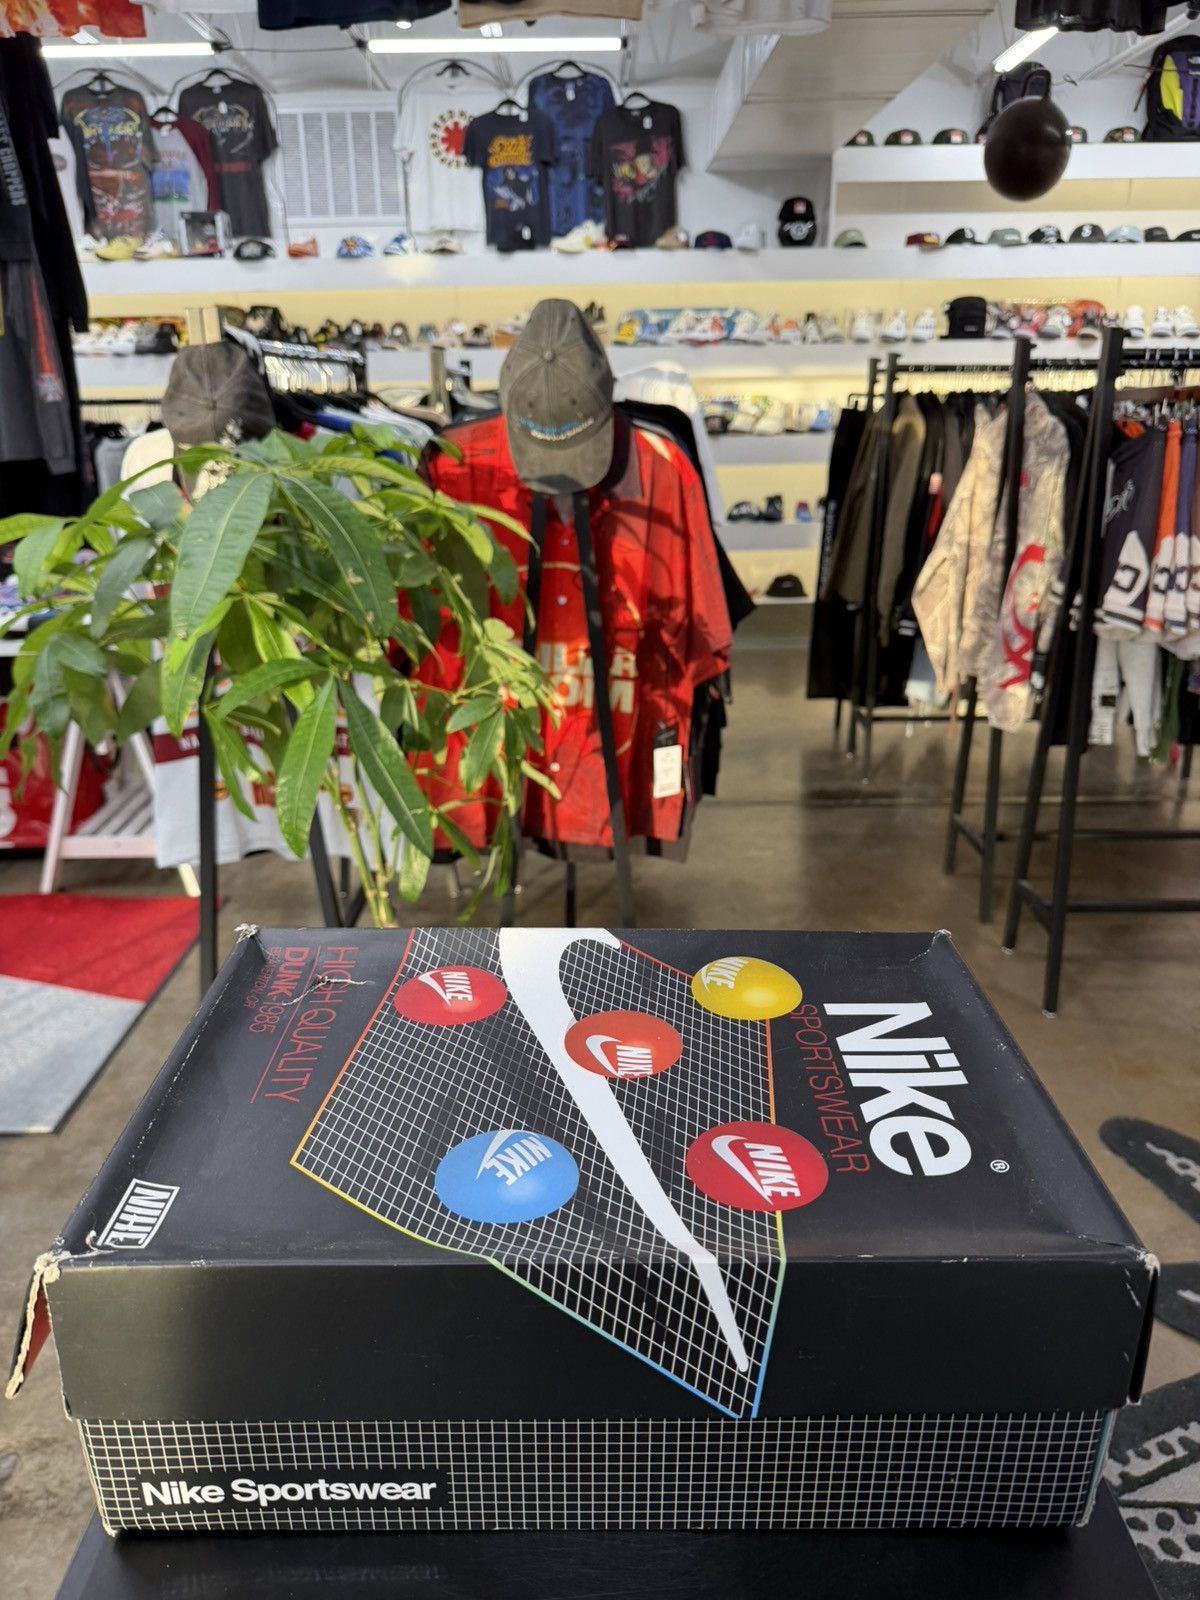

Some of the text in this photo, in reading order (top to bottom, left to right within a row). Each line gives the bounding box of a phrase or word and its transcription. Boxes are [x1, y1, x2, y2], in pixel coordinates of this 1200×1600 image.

[441, 971, 473, 1001] NIKE
[706, 957, 749, 989] NIKE
[264, 947, 359, 1103] HIGH QUALITY
[616, 1045, 653, 1076] NIKE
[791, 1004, 871, 1173] SPORTSWEAR
[823, 1002, 972, 1176] Nike
[484, 1136, 552, 1186] NIKE
[743, 1142, 801, 1197] NIKE
[141, 1478, 437, 1507] Nike Sportswear
